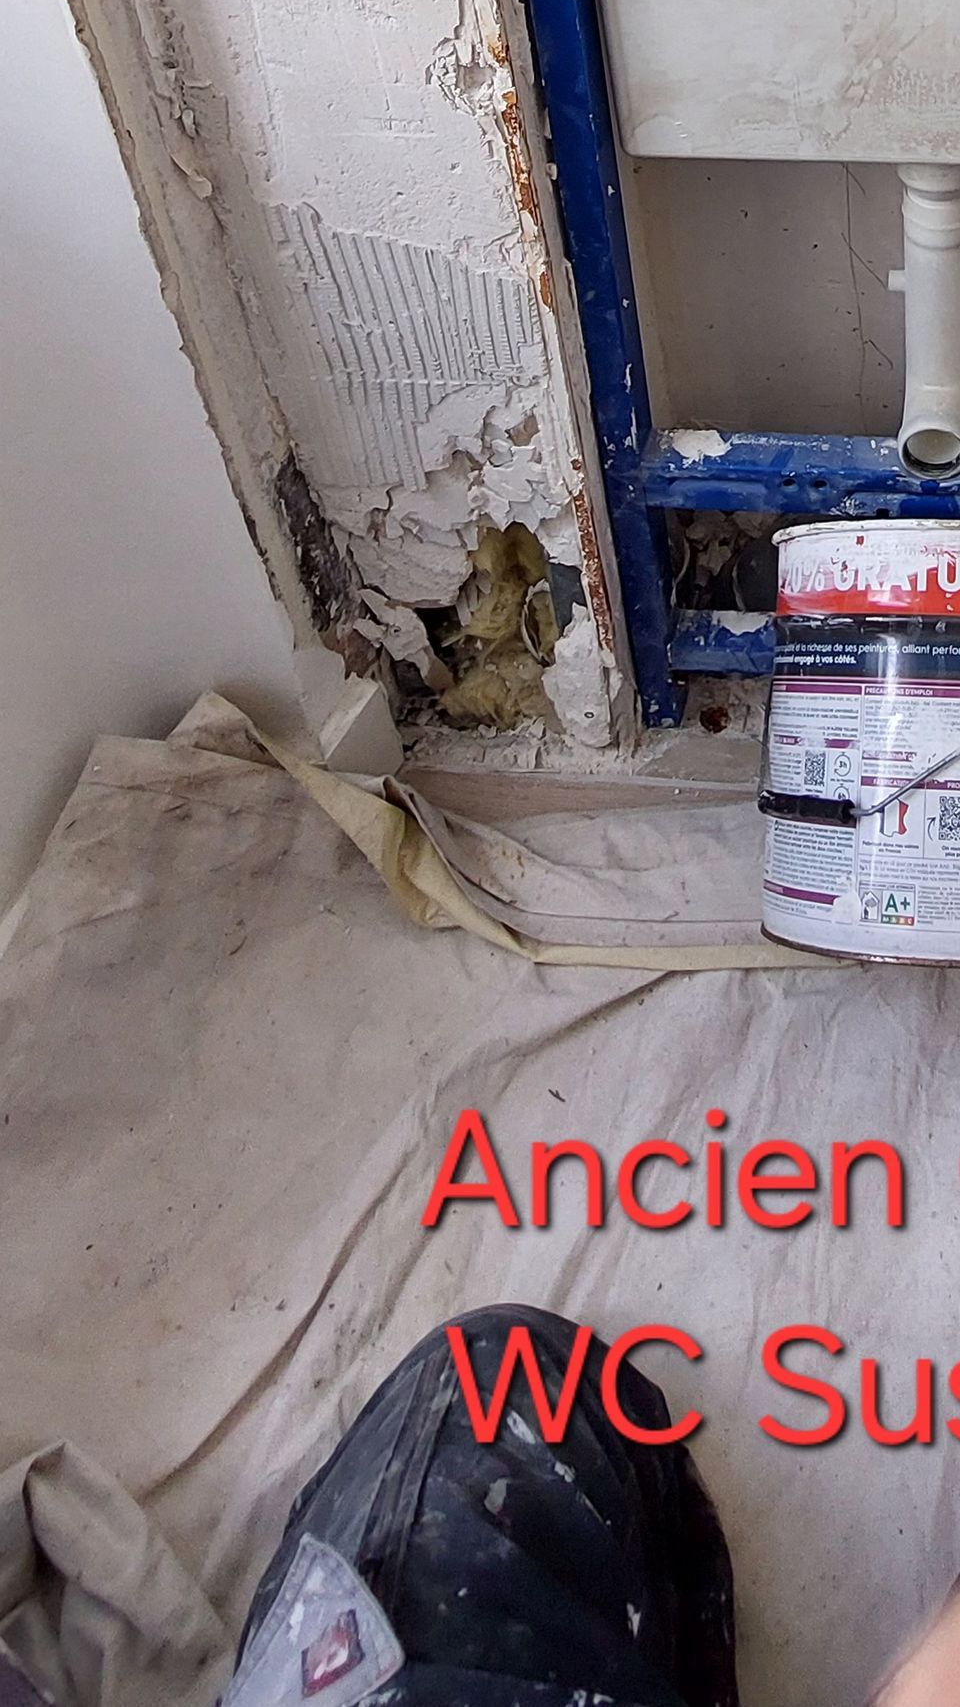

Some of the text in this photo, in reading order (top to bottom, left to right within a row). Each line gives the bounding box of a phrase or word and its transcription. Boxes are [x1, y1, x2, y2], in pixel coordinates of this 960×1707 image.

[833, 643, 844, 652] de
[845, 644, 857, 653] ses
[902, 644, 930, 654] alliant
[821, 655, 834, 664] vos
[884, 892, 911, 913] A+
